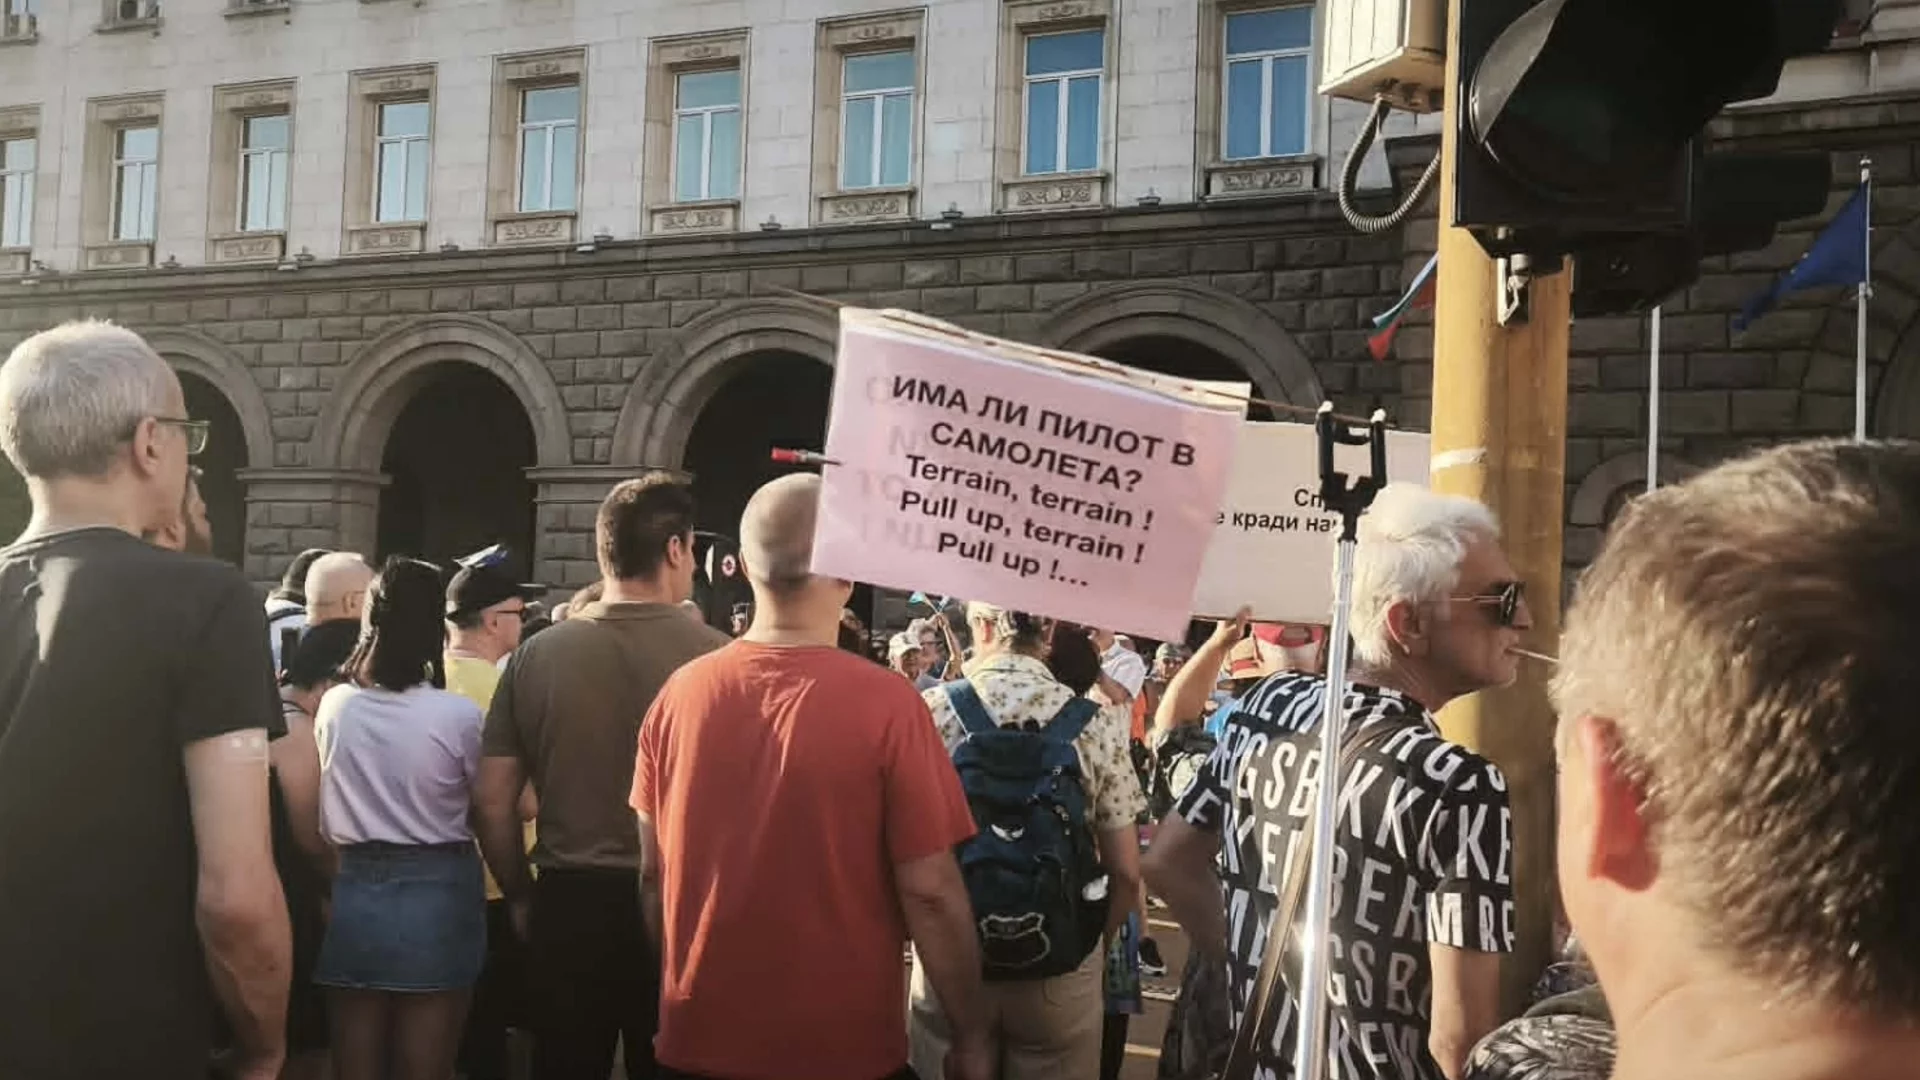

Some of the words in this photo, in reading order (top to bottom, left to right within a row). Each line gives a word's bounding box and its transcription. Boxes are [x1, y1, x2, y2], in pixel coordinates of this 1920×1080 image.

[893, 375, 968, 414] ИМА
[977, 396, 1029, 427] ЛИ
[1037, 409, 1164, 459] ПИЛОТ
[1171, 442, 1196, 466] В
[905, 453, 1018, 502] Terrain,
[1030, 483, 1133, 528] terrain
[930, 422, 1143, 493] САМОЛЕТА?
[899, 490, 958, 520] Pull
[966, 506, 1012, 537] up,
[1022, 517, 1125, 562] terrain
[1232, 512, 1299, 532] кради
[1294, 488, 1326, 510] Сп
[936, 532, 994, 563] Pull
[1001, 551, 1041, 578] up
